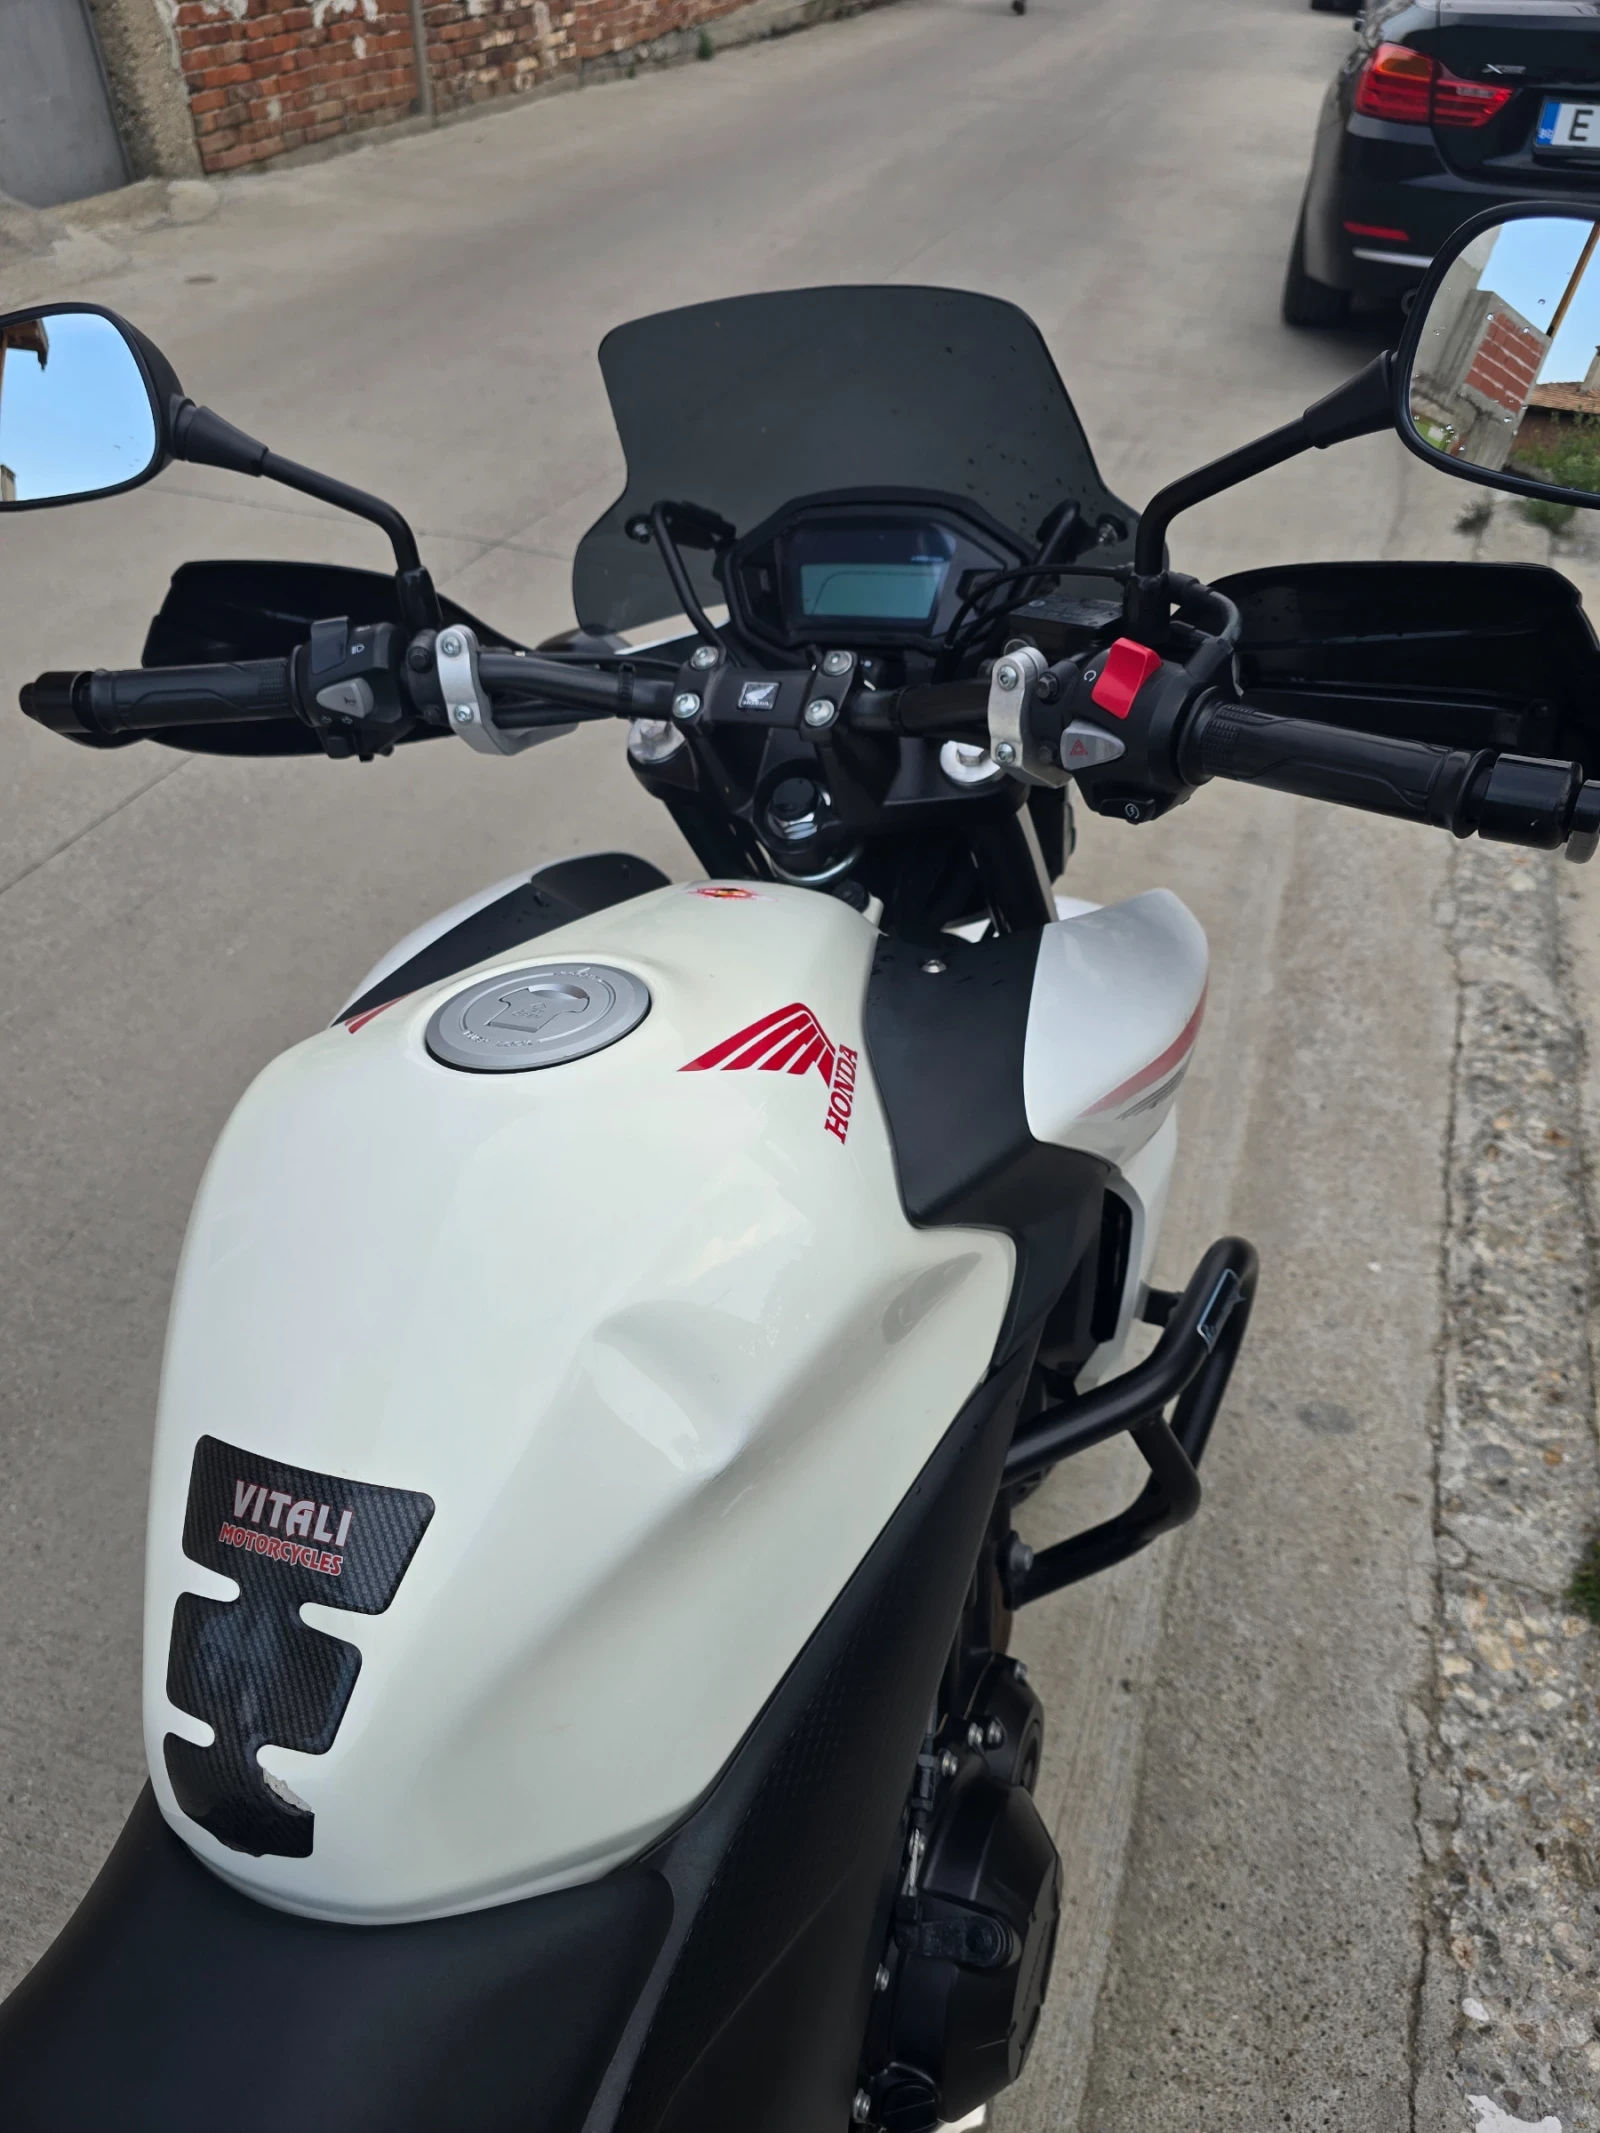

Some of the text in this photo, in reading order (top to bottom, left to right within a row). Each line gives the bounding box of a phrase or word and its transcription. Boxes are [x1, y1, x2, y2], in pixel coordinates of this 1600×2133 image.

[1568, 109, 1594, 142] E
[824, 1043, 858, 1145] HONDA
[233, 1480, 352, 1547] VITALI
[219, 1522, 344, 1576] MOTORCYCLES
